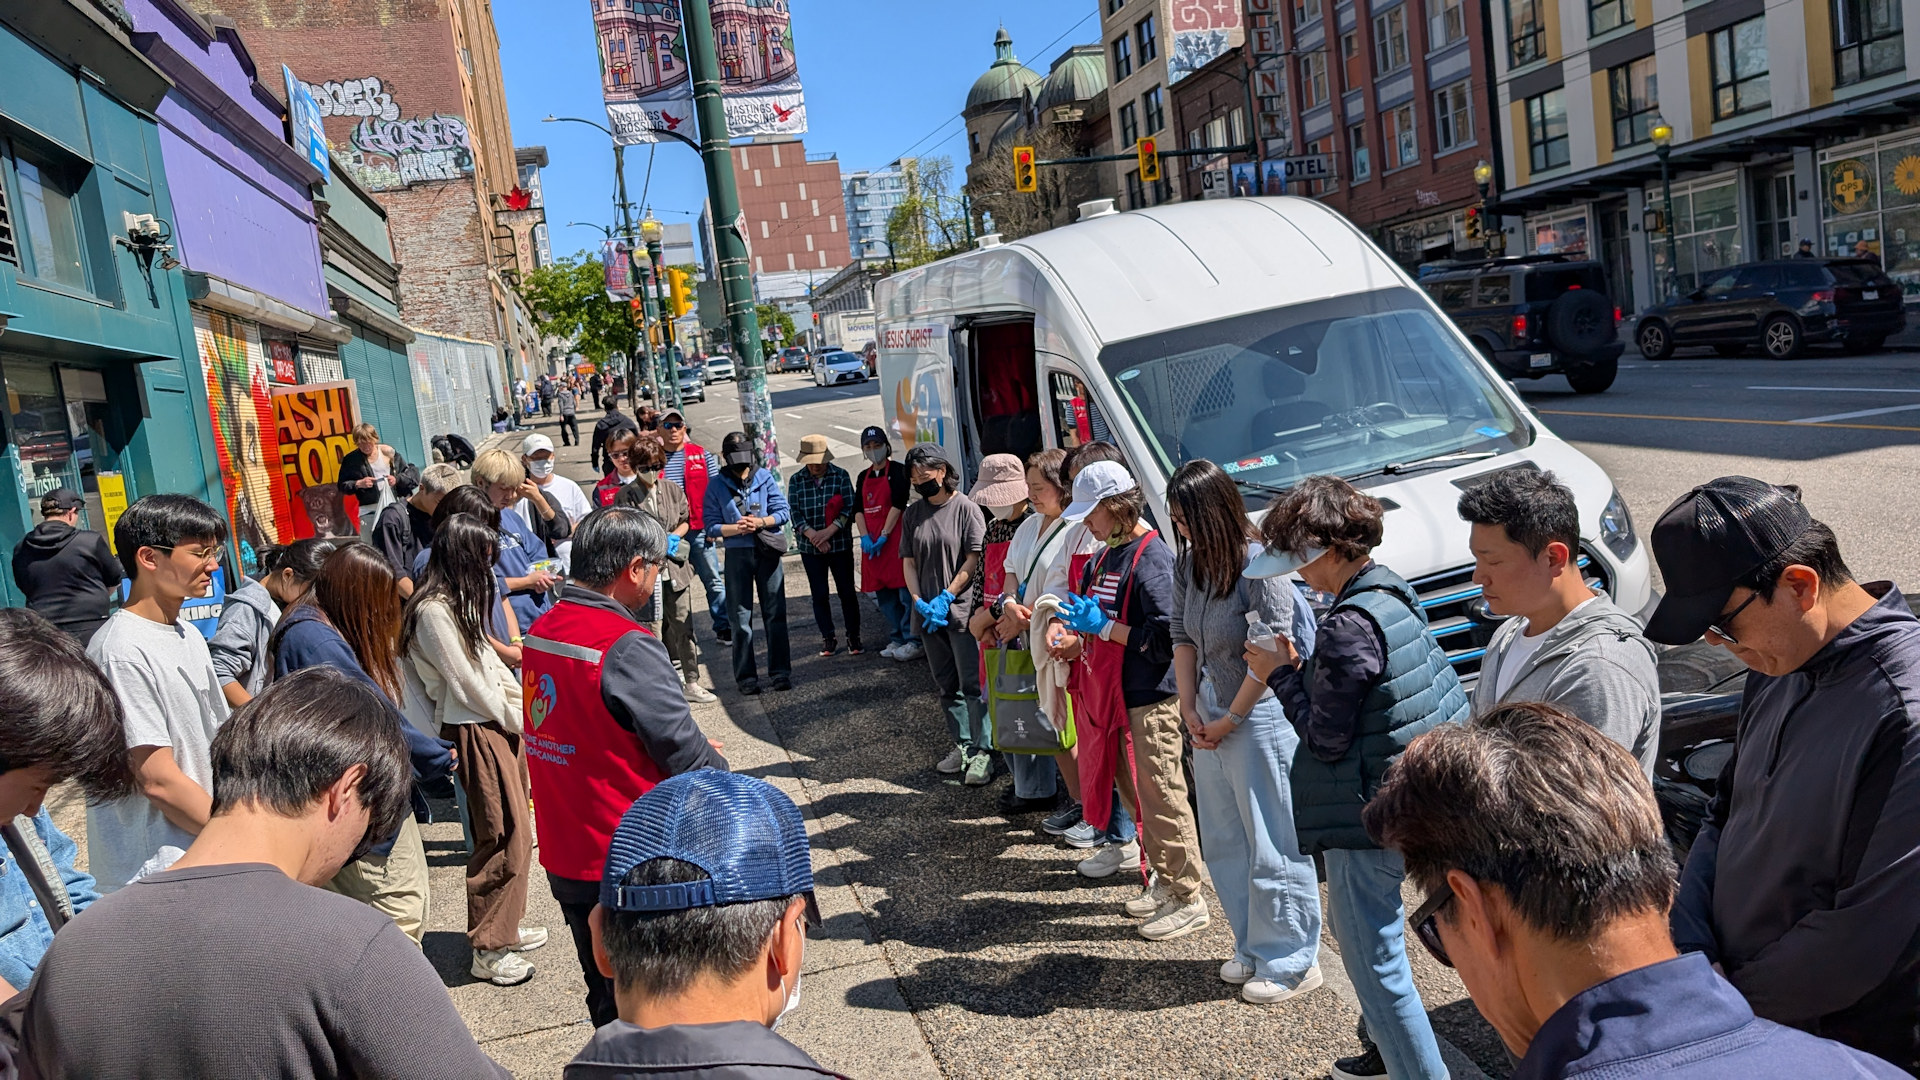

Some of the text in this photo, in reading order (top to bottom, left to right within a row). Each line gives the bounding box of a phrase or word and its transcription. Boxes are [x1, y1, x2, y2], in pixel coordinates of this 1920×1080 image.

[727, 103, 772, 116] HASTINGS
[613, 110, 660, 124] HASTINGS
[728, 112, 776, 126] CROSSING
[615, 121, 664, 134] CROSSING
[1285, 158, 1326, 177] OTEL
[1840, 181, 1858, 192] OPS
[884, 329, 904, 349] JESUS
[905, 328, 933, 348] CHRIST
[537, 739, 576, 755] ANOTHER
